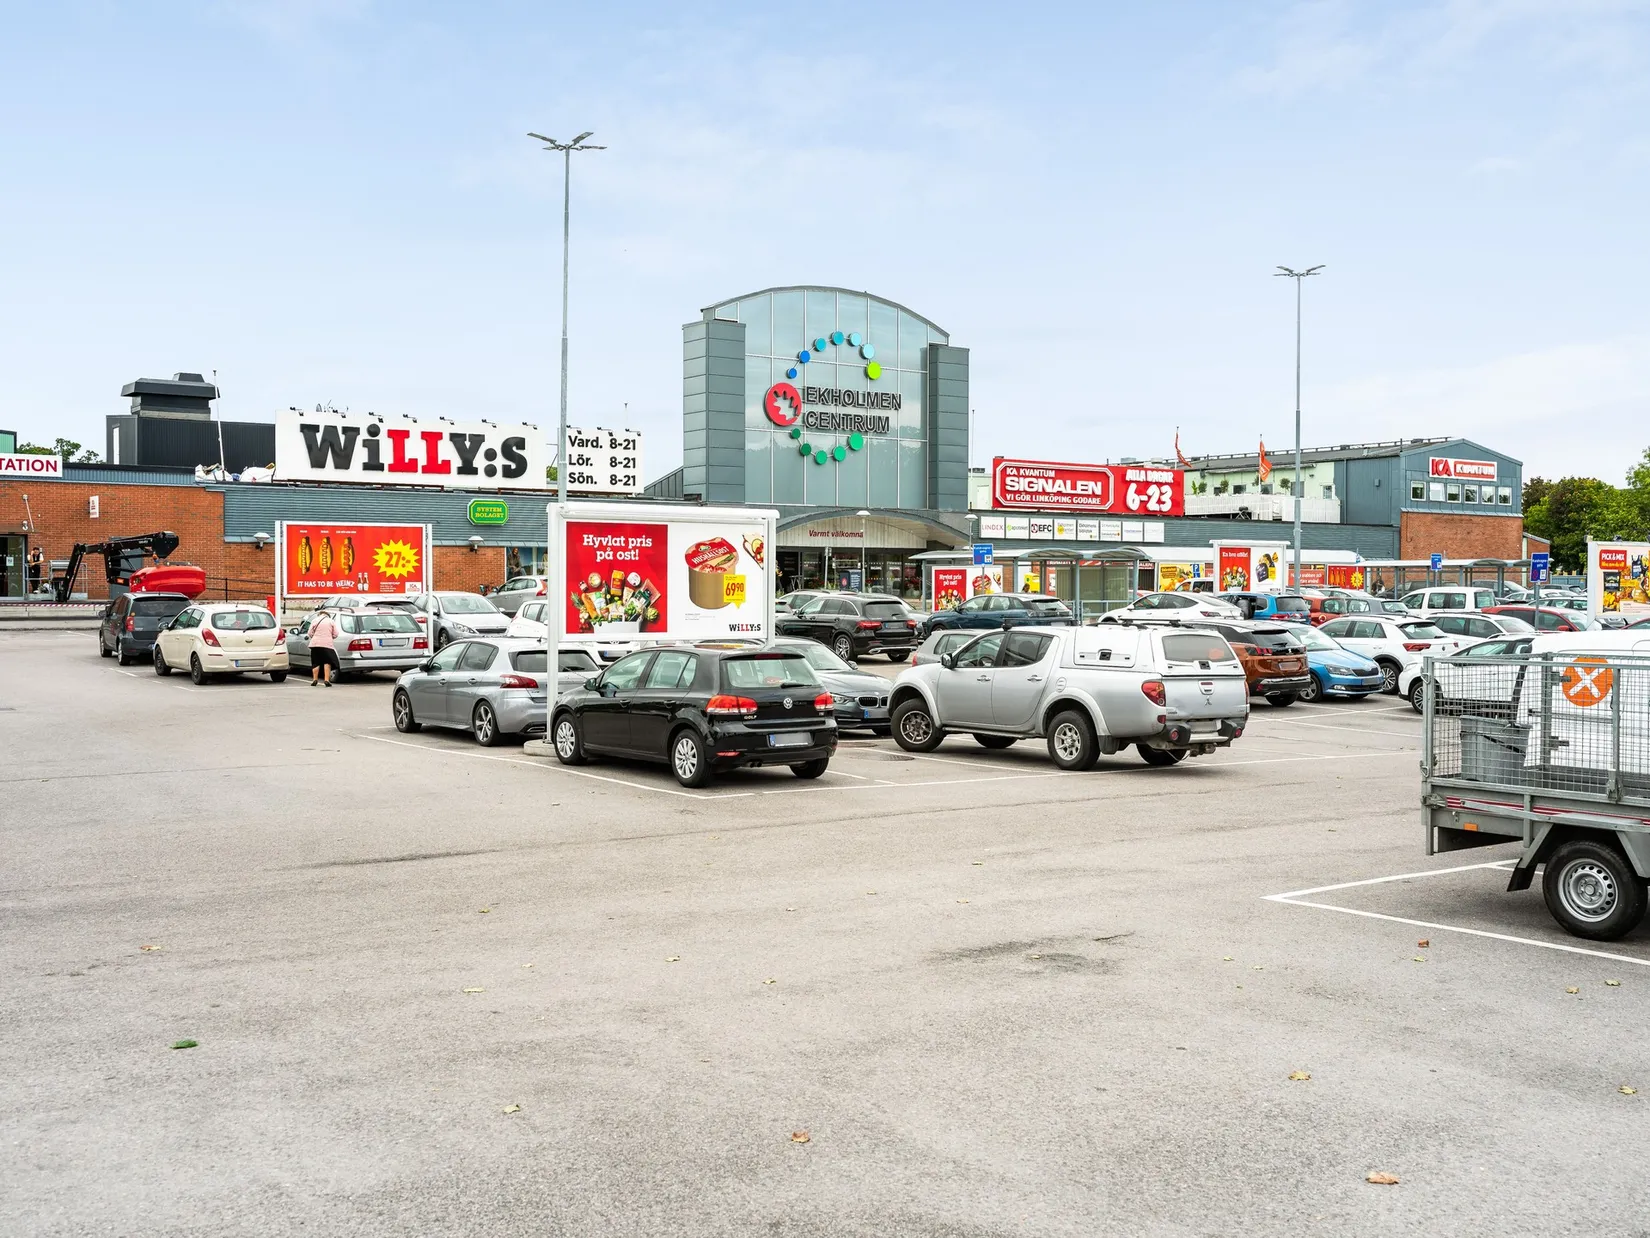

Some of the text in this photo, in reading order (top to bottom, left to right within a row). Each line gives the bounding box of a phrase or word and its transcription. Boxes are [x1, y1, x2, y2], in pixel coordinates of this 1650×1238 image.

[805, 386, 903, 411] EKHOLMEN
[805, 411, 890, 433] CENTRUM
[299, 423, 528, 479] WiLLY:S
[568, 435, 636, 451] Vard. 8-21
[568, 454, 636, 469] Lör. 8-21
[1431, 458, 1453, 477] ICA
[568, 472, 636, 487] Sön. 8-21
[1006, 467, 1056, 478] ICA KVANTUM
[1125, 469, 1175, 483] ALLA DAGAR
[1005, 476, 1103, 496] SIGNALEN
[1006, 492, 1102, 505] VI GÖR LINKÖPING GODARE
[1126, 482, 1173, 513] 6-23
[808, 529, 864, 538] Varmt välkomna
[1038, 524, 1052, 533] EFC
[582, 534, 653, 550] Hyvlat pris
[384, 550, 411, 569] 27:-
[596, 547, 640, 563] på ost!
[335, 580, 355, 588] HEINZ
